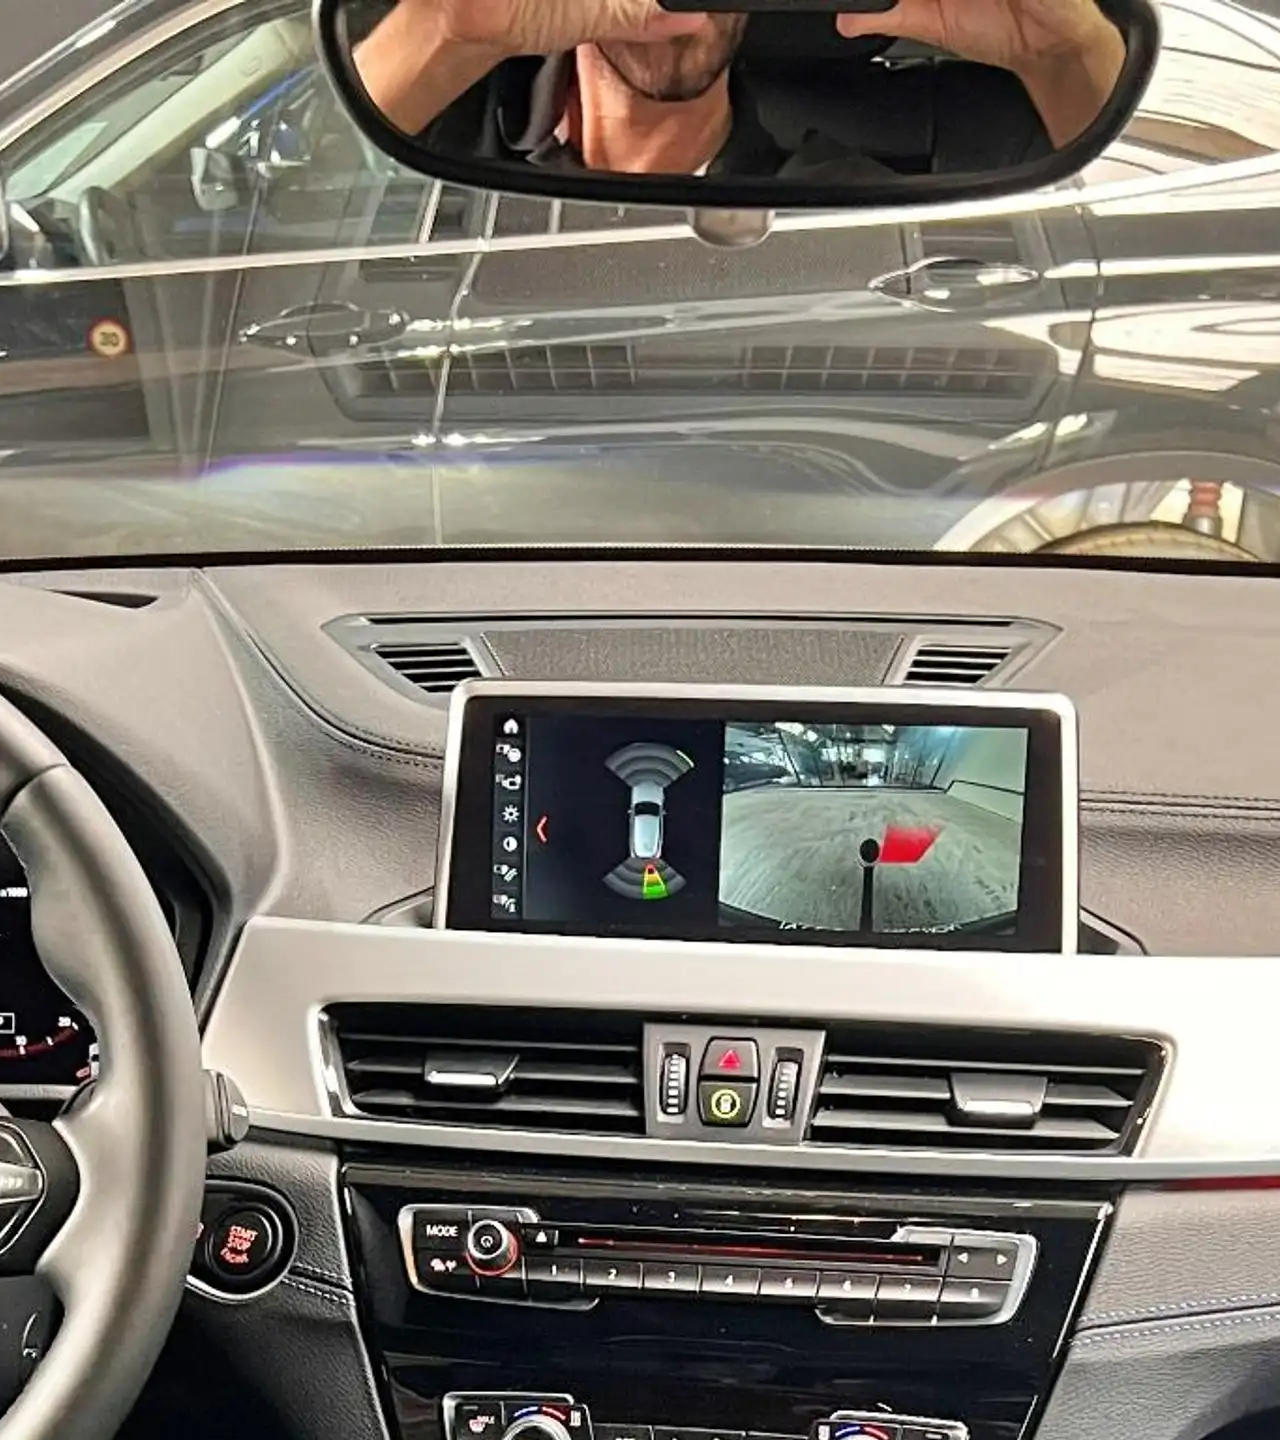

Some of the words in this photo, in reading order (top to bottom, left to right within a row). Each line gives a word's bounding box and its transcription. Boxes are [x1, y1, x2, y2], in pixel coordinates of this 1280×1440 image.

[426, 1225, 458, 1237] MODE
[551, 1264, 557, 1276] 1
[609, 1269, 617, 1279] 2
[668, 1272, 676, 1282] 3
